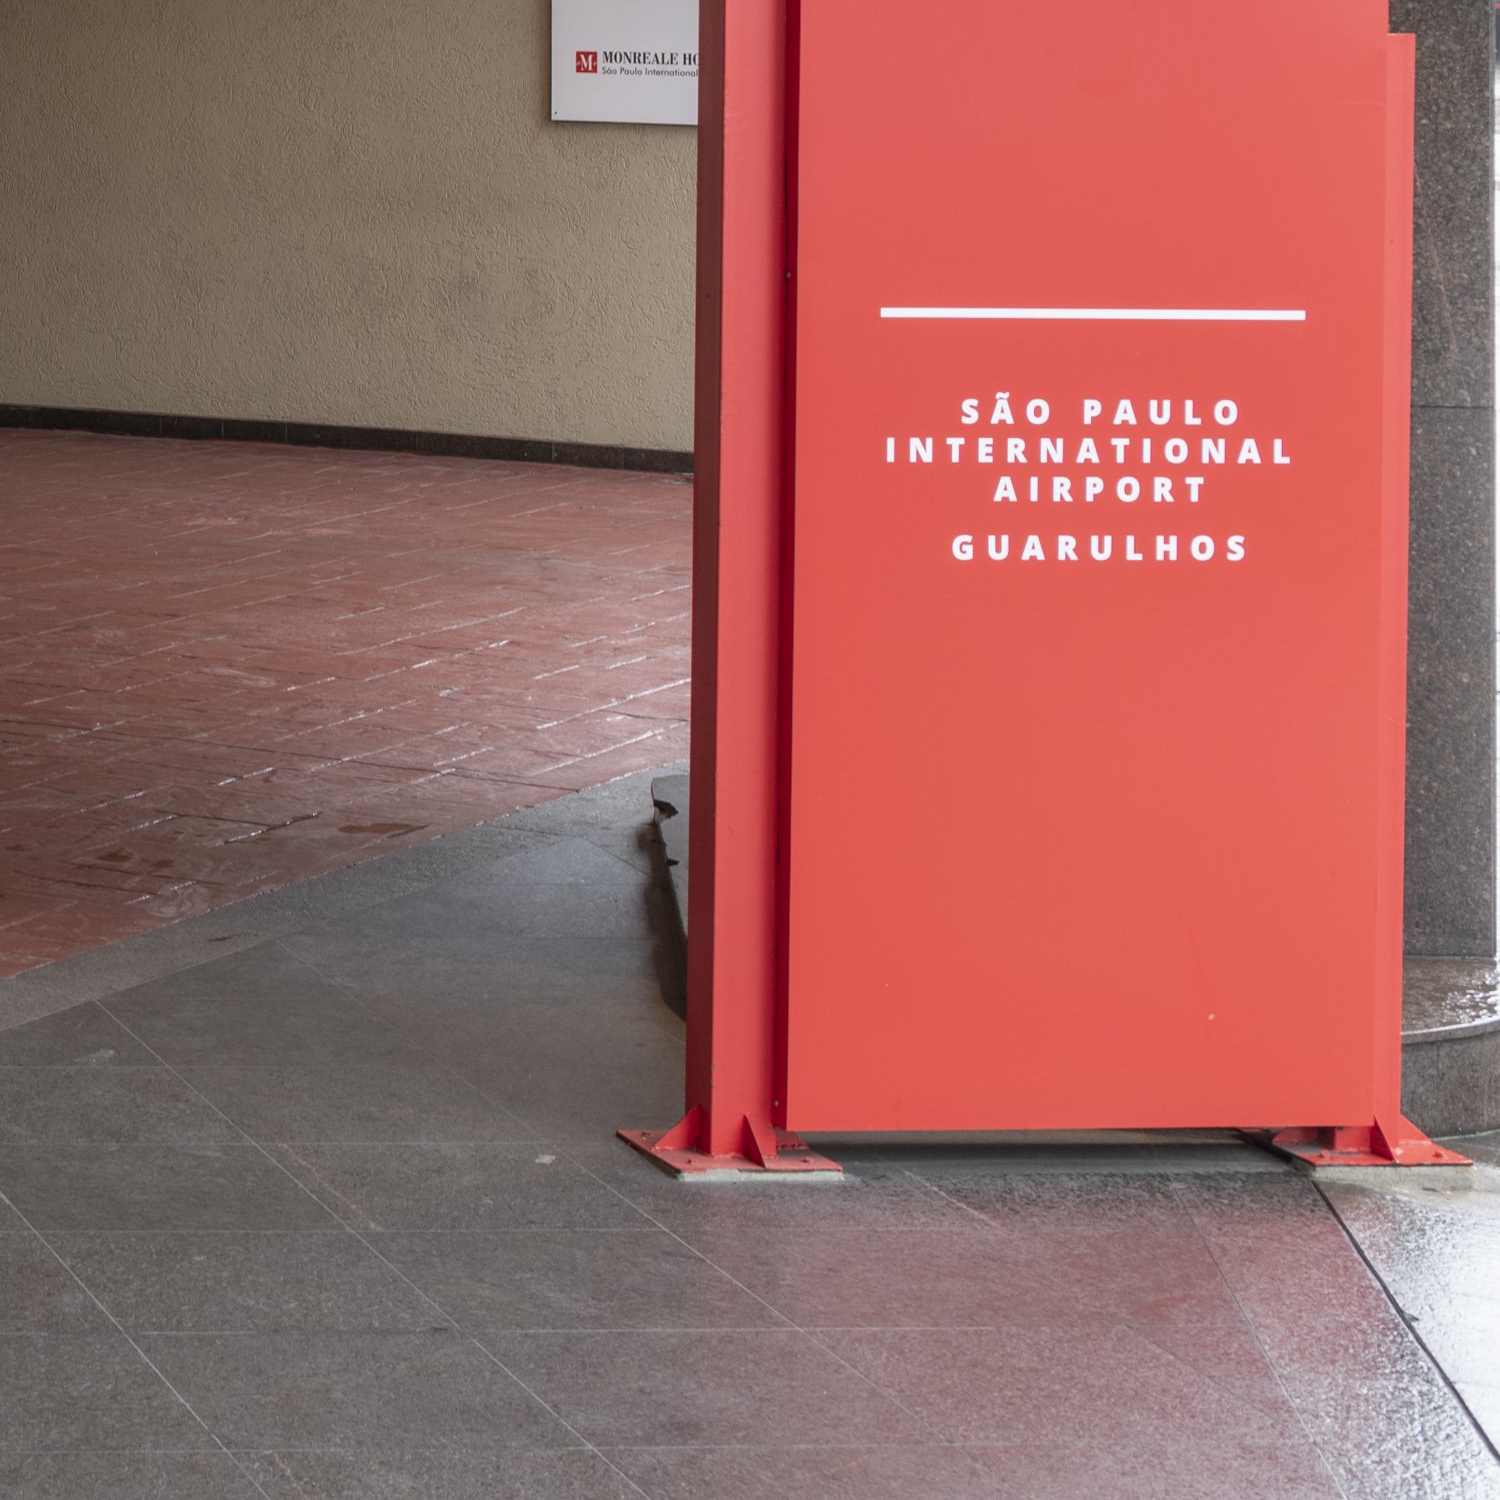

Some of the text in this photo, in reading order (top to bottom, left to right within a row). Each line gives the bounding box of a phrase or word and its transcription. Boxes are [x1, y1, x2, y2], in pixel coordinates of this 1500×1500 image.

[602, 51, 678, 65] MONREALE
[602, 66, 699, 77] São Paulo International
[961, 391, 1238, 426] SÃO PAULO
[886, 437, 1291, 464] INTERNATIONAL
[993, 476, 1205, 502] AIRPORT
[952, 534, 1245, 561] GUARULHOS
